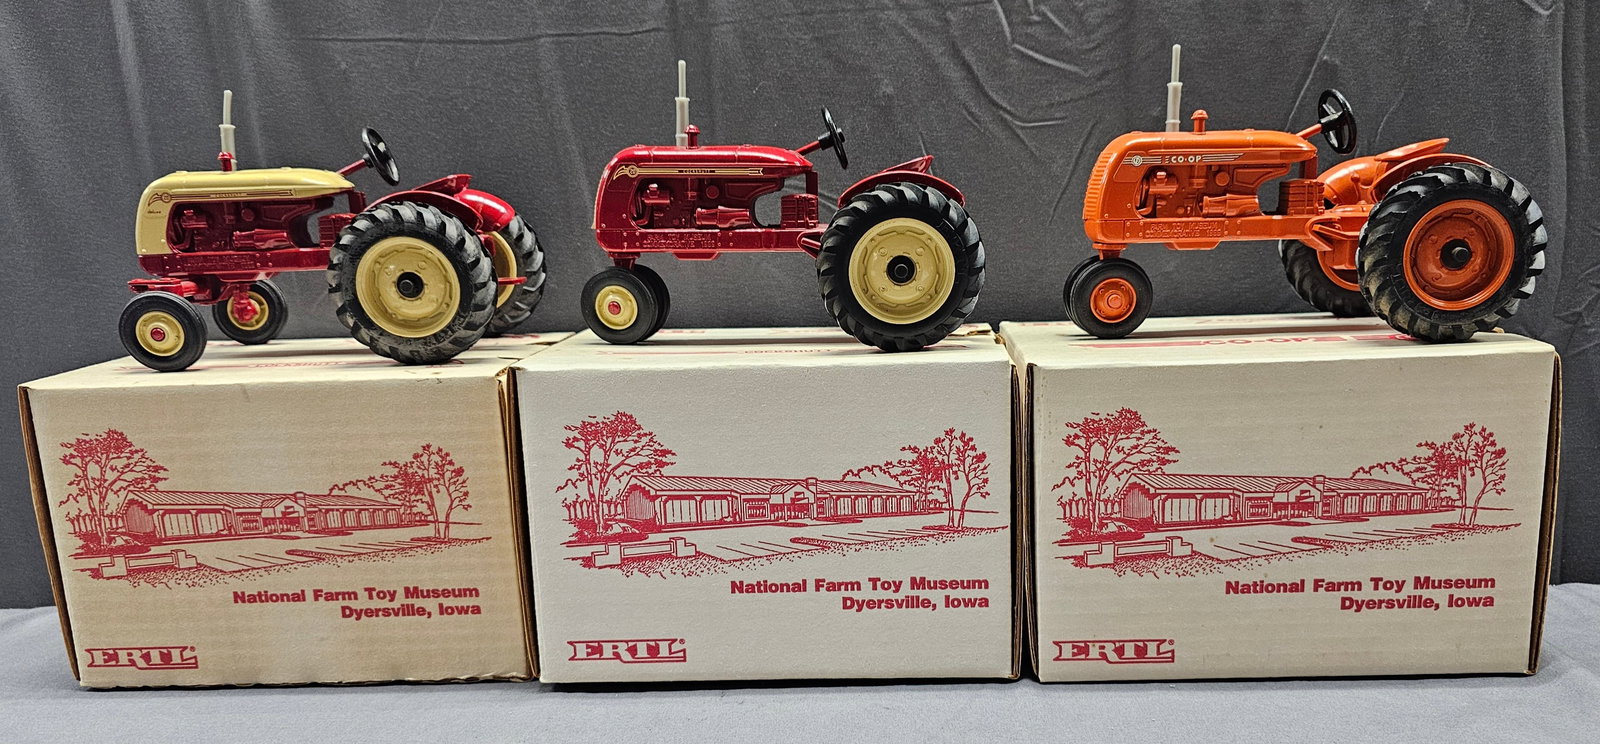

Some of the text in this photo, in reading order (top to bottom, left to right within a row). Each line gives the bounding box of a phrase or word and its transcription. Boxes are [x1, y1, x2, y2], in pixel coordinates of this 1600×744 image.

[232, 585, 480, 605] National Farm Toy Museum
[730, 576, 990, 596] National Farm Toy Museum
[1225, 575, 1496, 596] National Farm Toy Museum
[340, 602, 482, 621] Dyersville, Iowa
[841, 593, 990, 612] Dyersville, Iowa
[1340, 593, 1495, 613] Dyersville, Iowa
